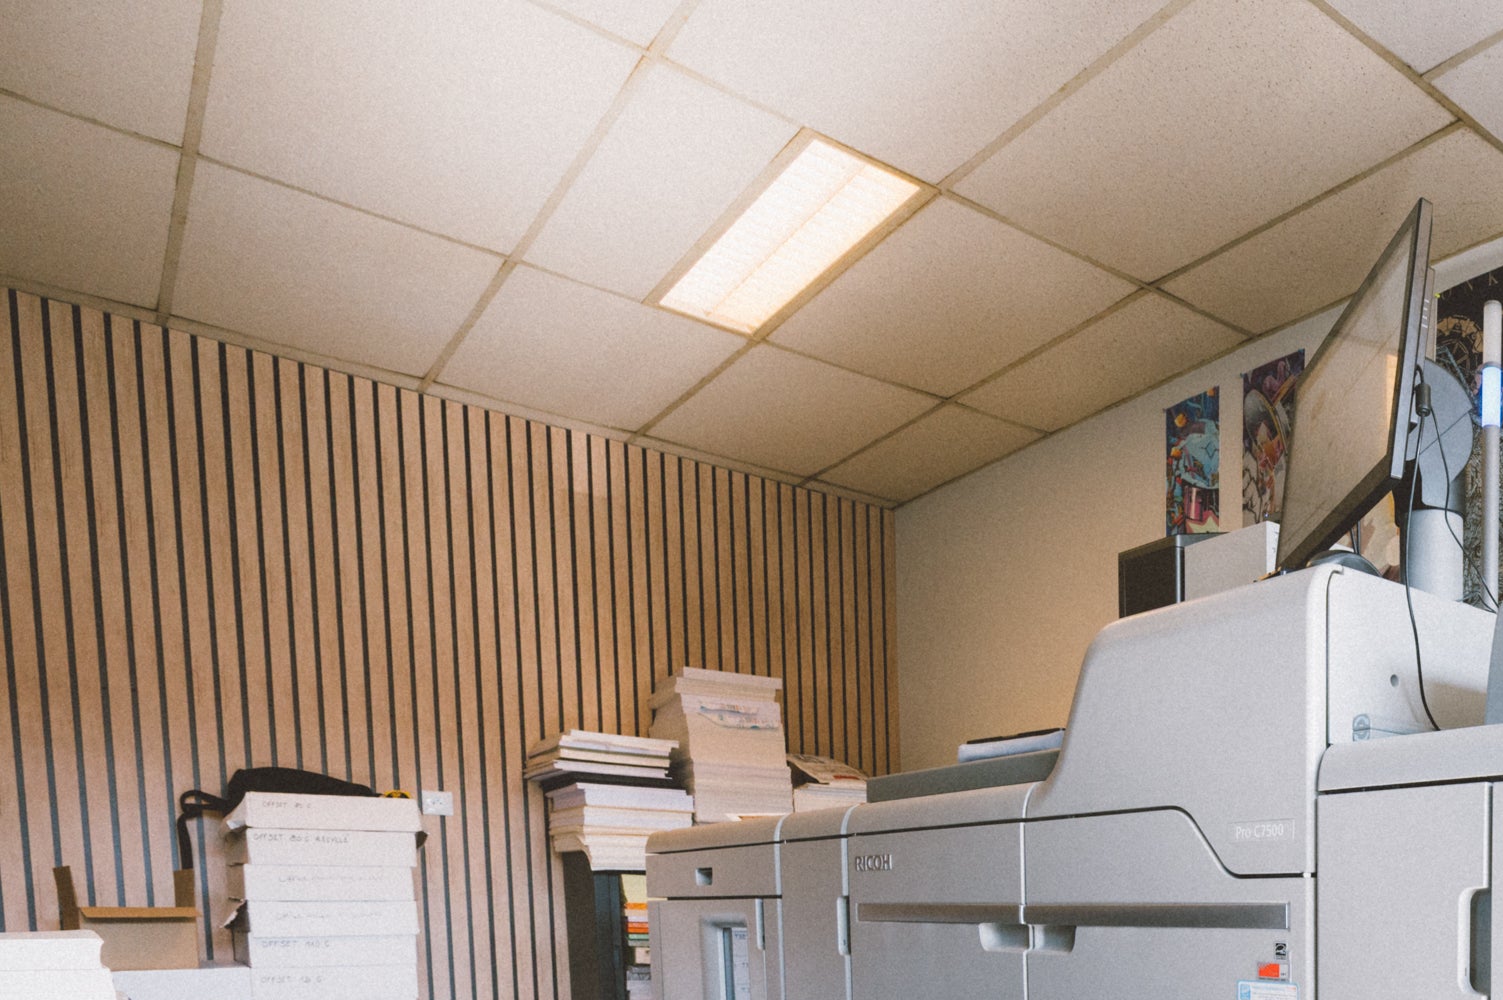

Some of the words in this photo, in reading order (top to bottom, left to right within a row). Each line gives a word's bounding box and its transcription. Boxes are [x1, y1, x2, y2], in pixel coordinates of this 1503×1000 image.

[1235, 825, 1251, 839] Pro
[1254, 822, 1284, 838] C7500
[855, 853, 892, 872] RICOH
